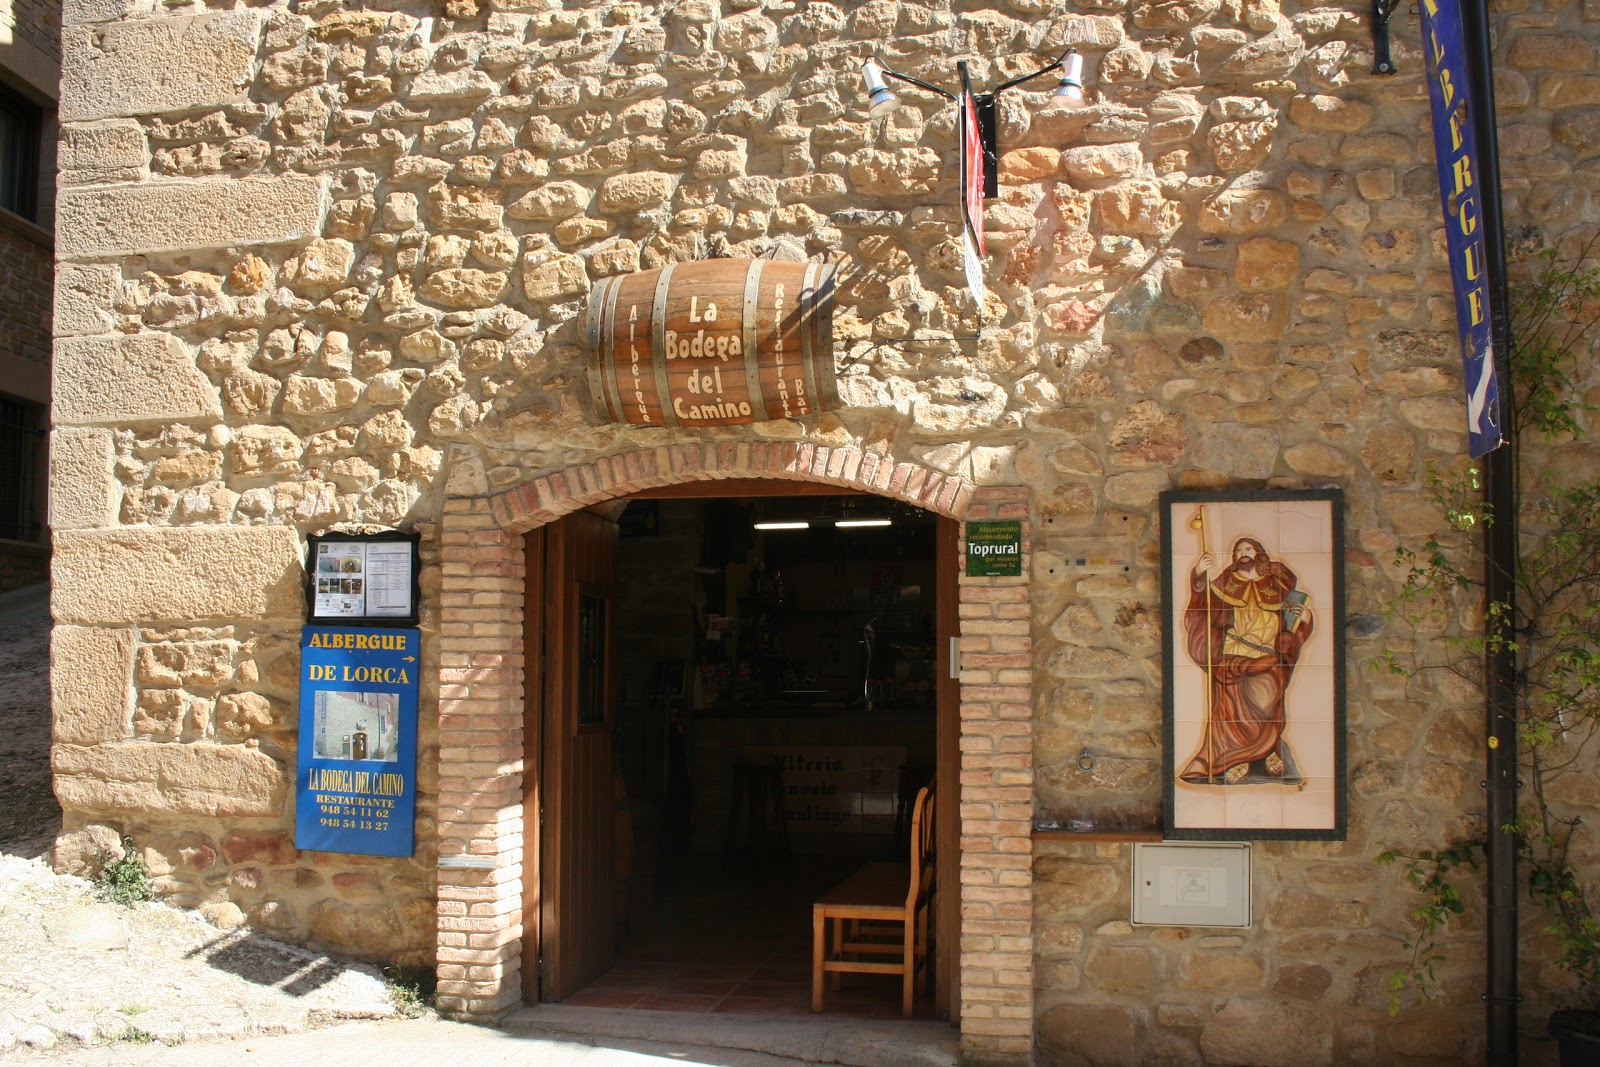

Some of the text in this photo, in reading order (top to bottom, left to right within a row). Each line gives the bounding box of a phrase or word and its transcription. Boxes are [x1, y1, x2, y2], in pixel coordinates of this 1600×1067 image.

[690, 296, 718, 323] La
[665, 329, 742, 362] Bodega
[774, 283, 793, 419] Restaurante
[628, 305, 651, 423] Albergue
[687, 366, 723, 395] del
[673, 397, 751, 420] Camino
[794, 378, 807, 415] Bar
[968, 542, 1018, 557] Toprural
[309, 633, 406, 651] ALBERGUE
[309, 664, 409, 684] DE LORCA
[308, 768, 404, 797] LA BODEGA DEL CAMINO
[316, 794, 395, 808] RESTAURANTE
[320, 805, 389, 818] 948 54 11 62
[320, 818, 389, 831] 948 54 13 27
